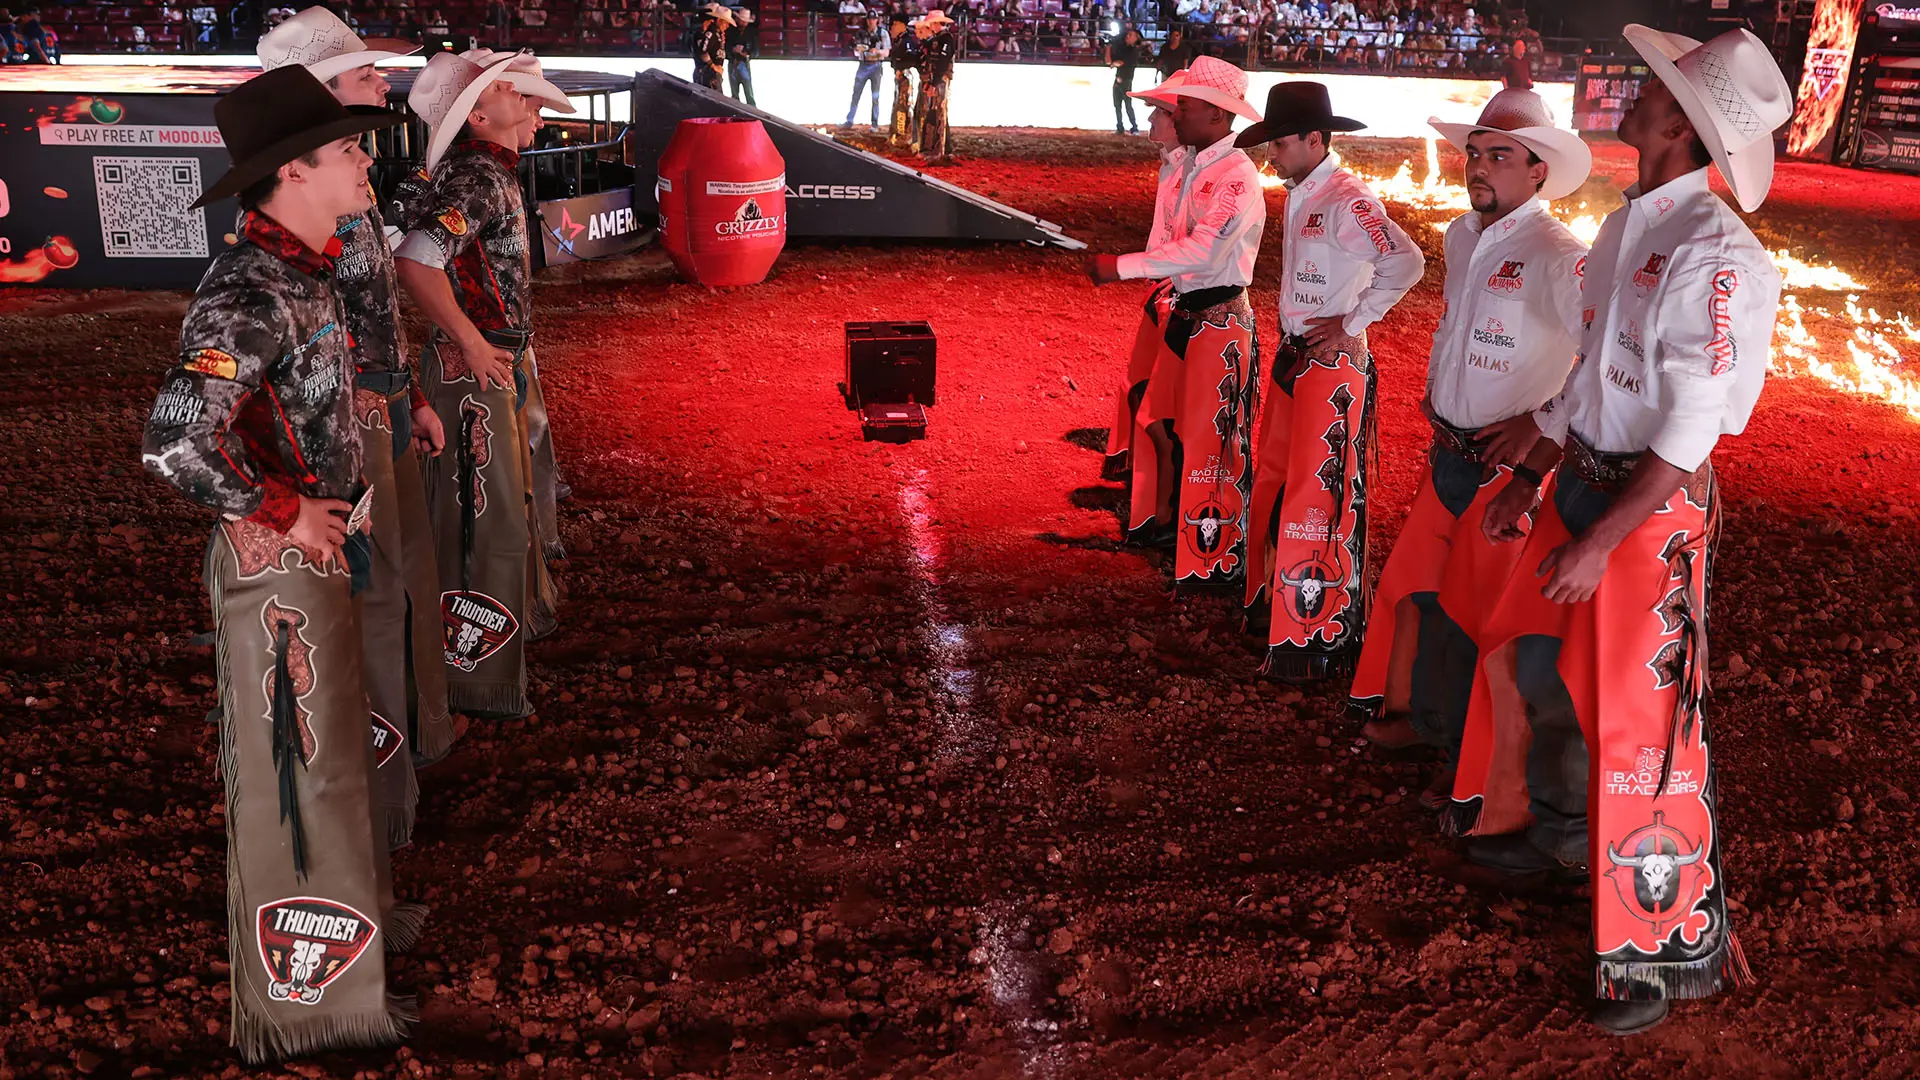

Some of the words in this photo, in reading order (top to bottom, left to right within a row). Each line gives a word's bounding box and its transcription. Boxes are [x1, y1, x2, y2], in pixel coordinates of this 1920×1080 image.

[67, 128, 98, 142] PLAY
[102, 129, 135, 143] FREE
[139, 130, 154, 143] AT
[159, 130, 221, 144] MODO.US
[715, 216, 780, 235] GRIZZLY
[1497, 260, 1525, 279] KC
[1642, 252, 1666, 275] KC
[1294, 292, 1324, 305] PALMS
[1473, 334, 1515, 349] MOWERS
[1474, 328, 1493, 338] BAD
[1494, 333, 1515, 342] BOY
[1468, 351, 1510, 374] PALMS
[1606, 364, 1642, 396] PALMS
[151, 405, 201, 423] RANCH
[1187, 476, 1235, 484] TRACTRS
[1191, 469, 1212, 477] BAD
[1288, 522, 1314, 533] BAD
[451, 595, 507, 633] THUNDER
[1613, 771, 1652, 784] BAD
[273, 906, 360, 943] THUNDER
